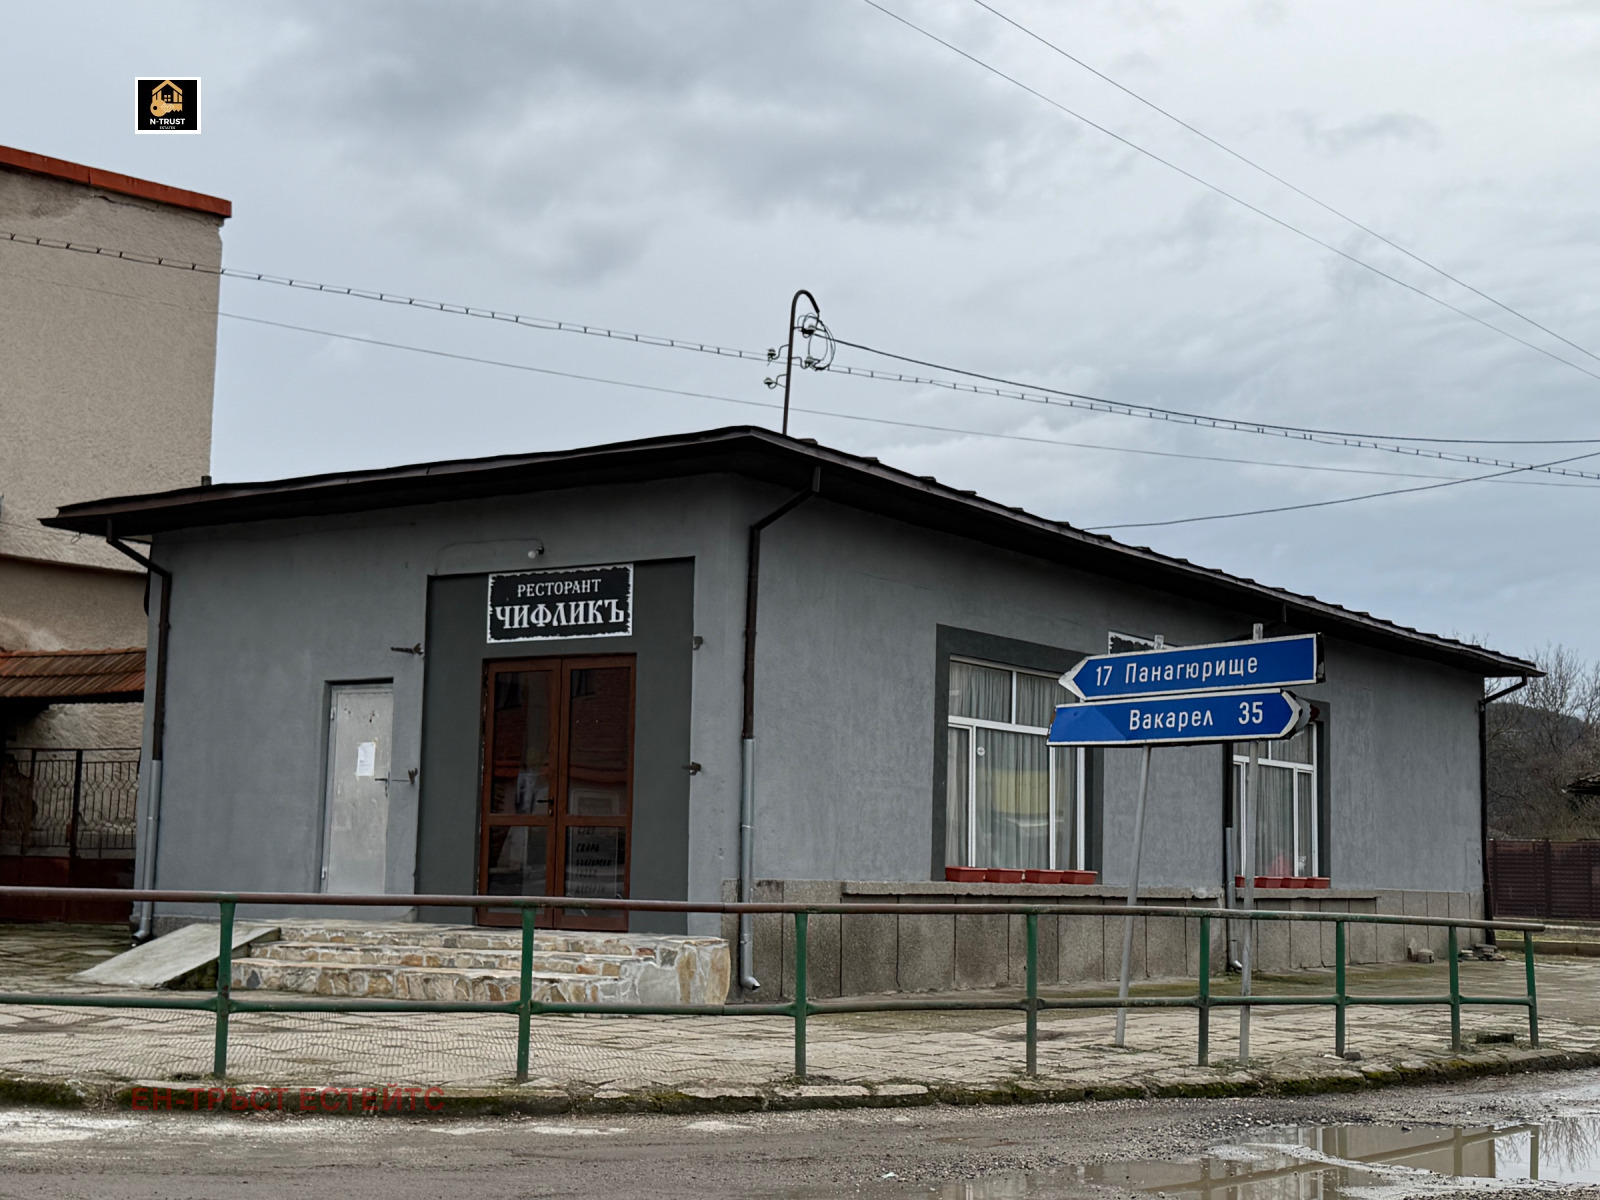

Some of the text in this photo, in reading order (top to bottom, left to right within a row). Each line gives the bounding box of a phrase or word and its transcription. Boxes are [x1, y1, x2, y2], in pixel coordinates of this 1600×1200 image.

[517, 578, 602, 597] РЕСТОРАНТ
[495, 599, 625, 629] ЧИФЛИКЪ
[1096, 656, 1258, 687] 17 Панагюрище
[1129, 701, 1264, 732] Вакарел 35
